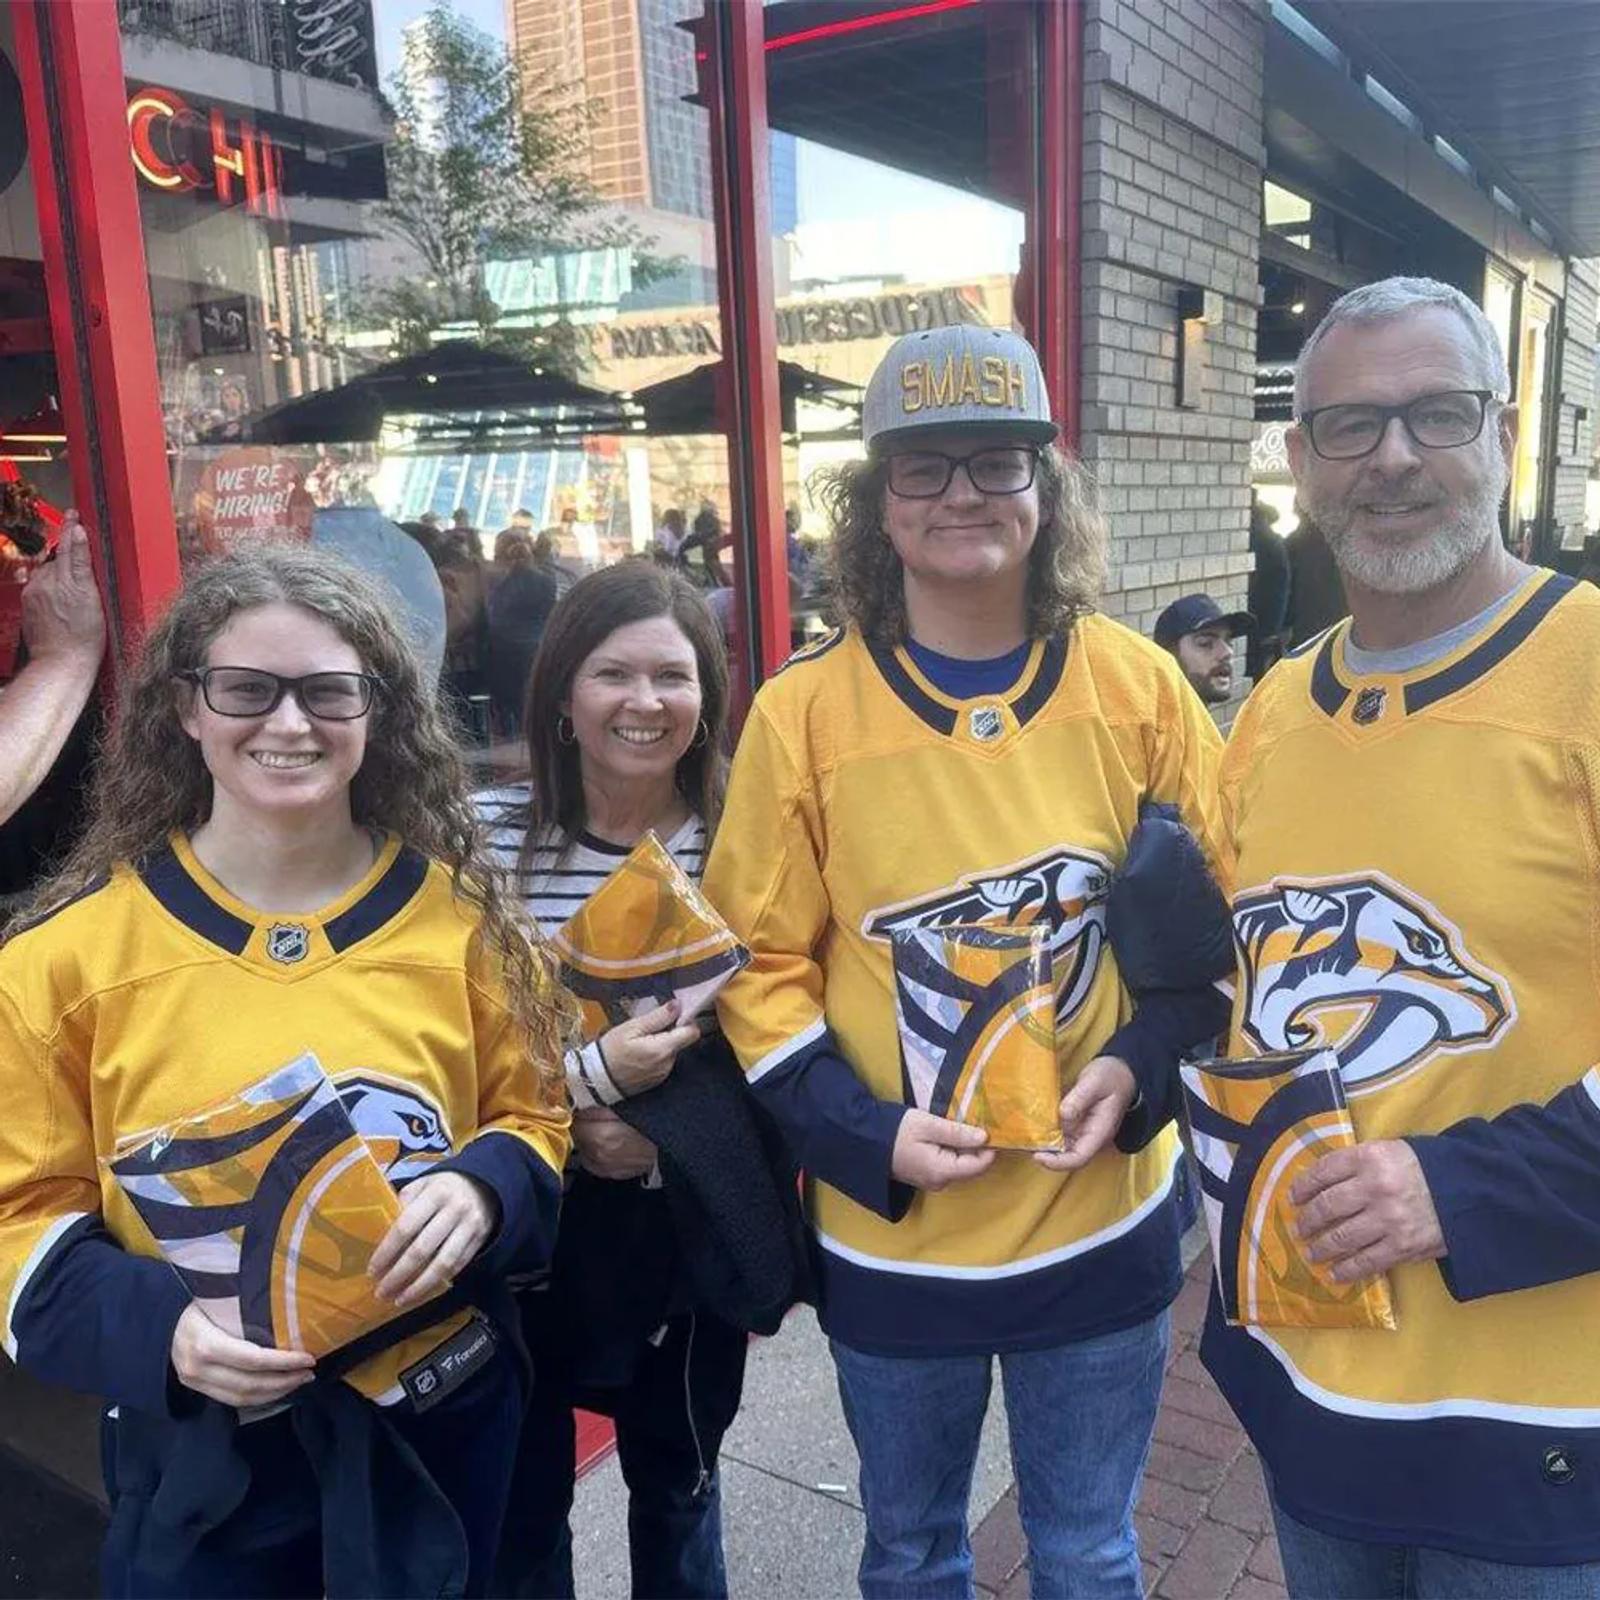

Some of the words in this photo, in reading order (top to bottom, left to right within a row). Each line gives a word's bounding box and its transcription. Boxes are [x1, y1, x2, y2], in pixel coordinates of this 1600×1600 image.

[902, 344, 1027, 413] SMASH
[215, 464, 283, 492] WE'RE
[213, 484, 294, 521] HIRING!
